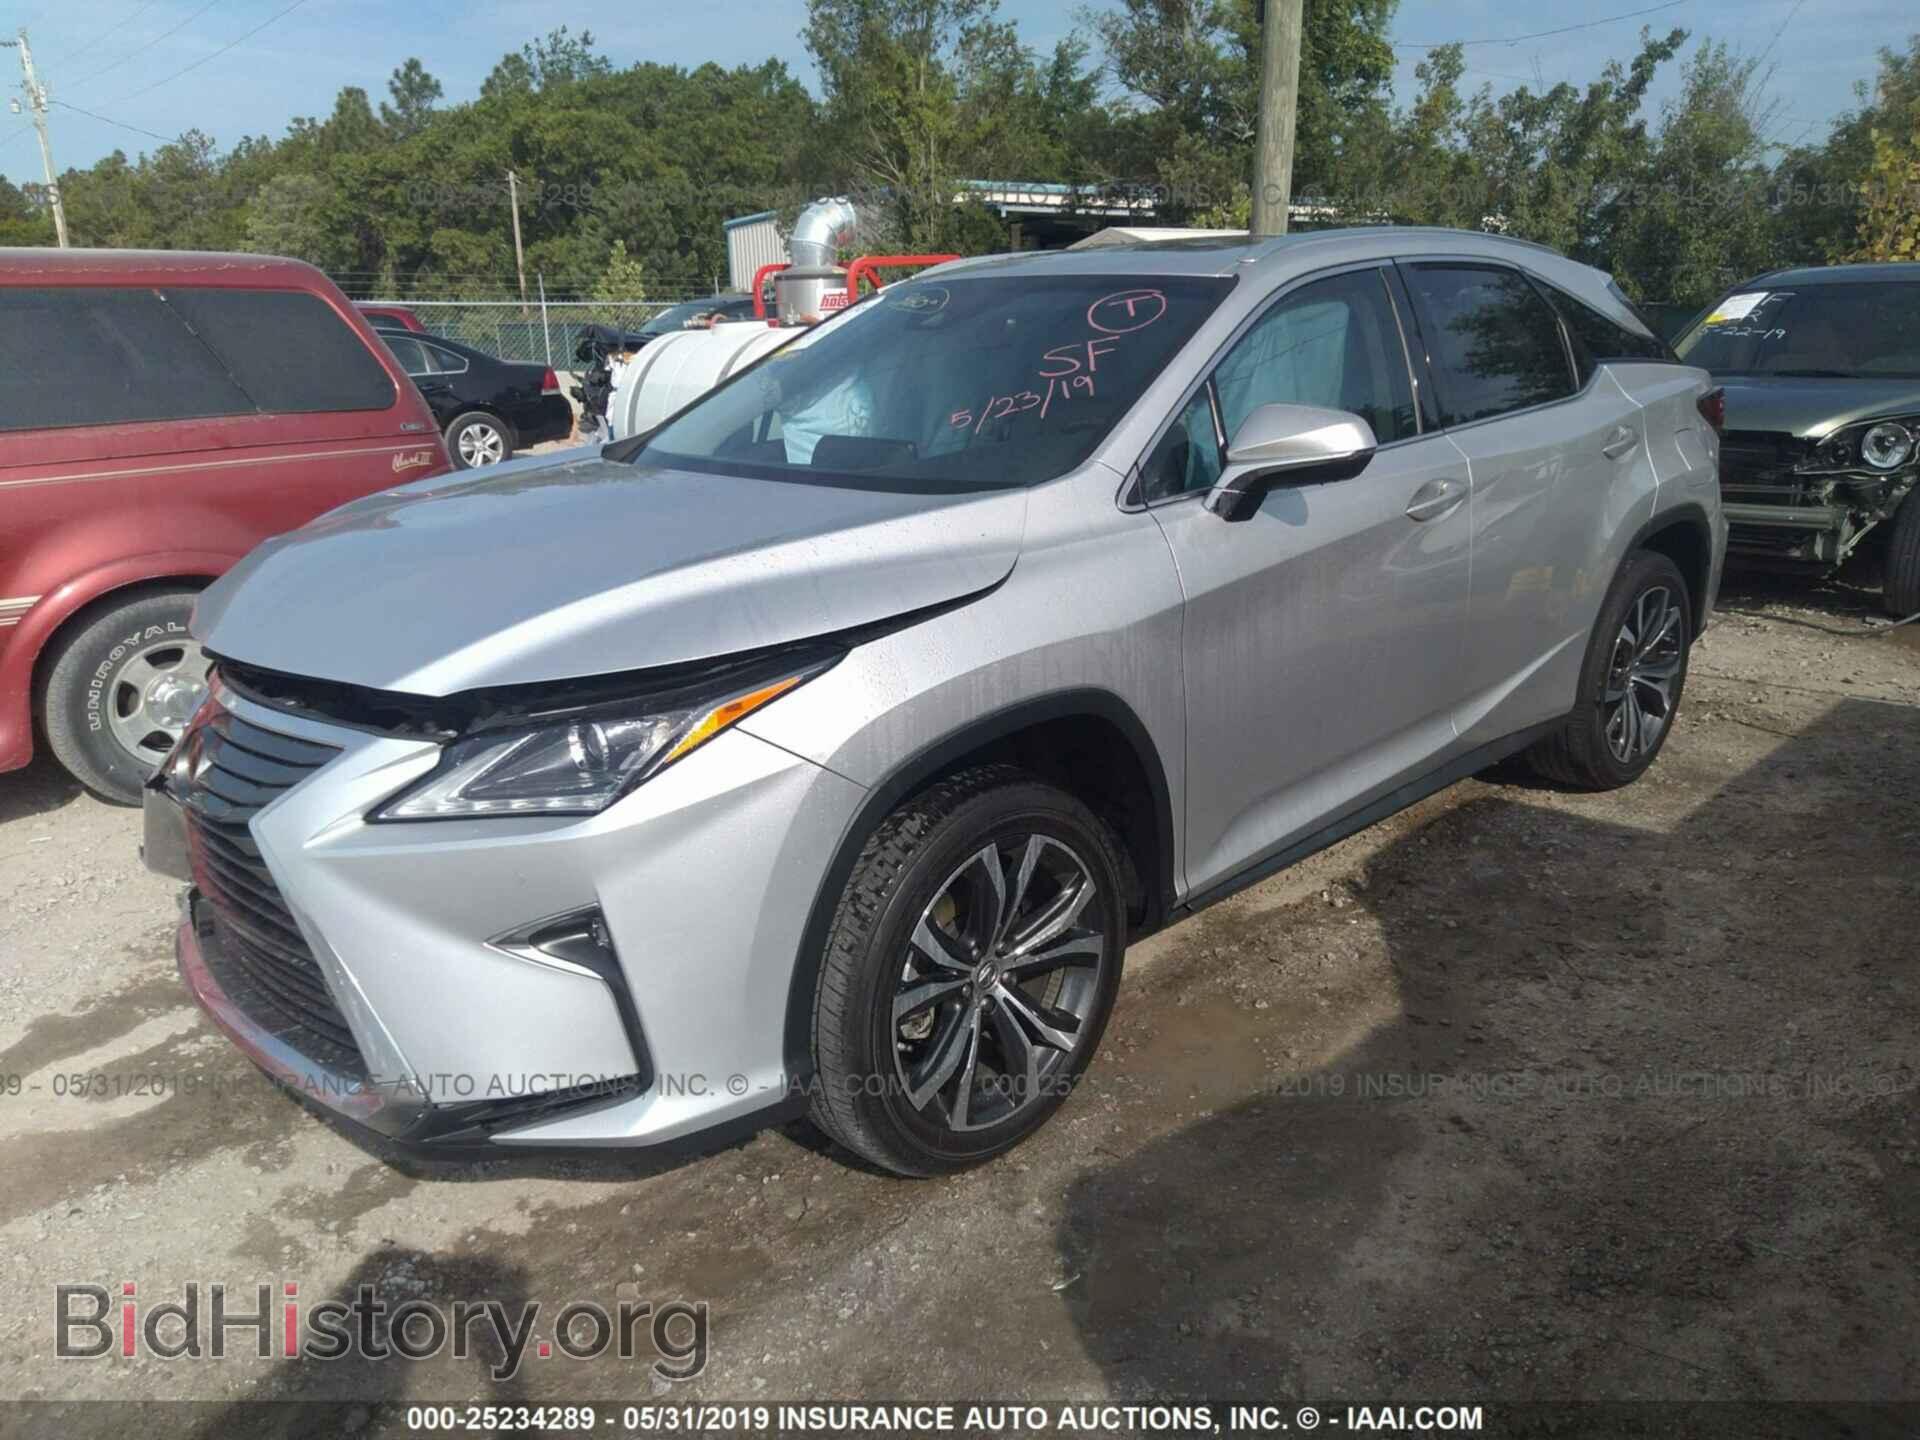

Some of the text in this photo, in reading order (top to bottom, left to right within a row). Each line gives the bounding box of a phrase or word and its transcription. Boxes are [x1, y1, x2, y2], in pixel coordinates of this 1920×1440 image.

[1108, 294, 1153, 317] T
[1038, 334, 1121, 378] SF
[950, 374, 1096, 435] 5/23/19
[87, 621, 187, 733] UNIROYAL
